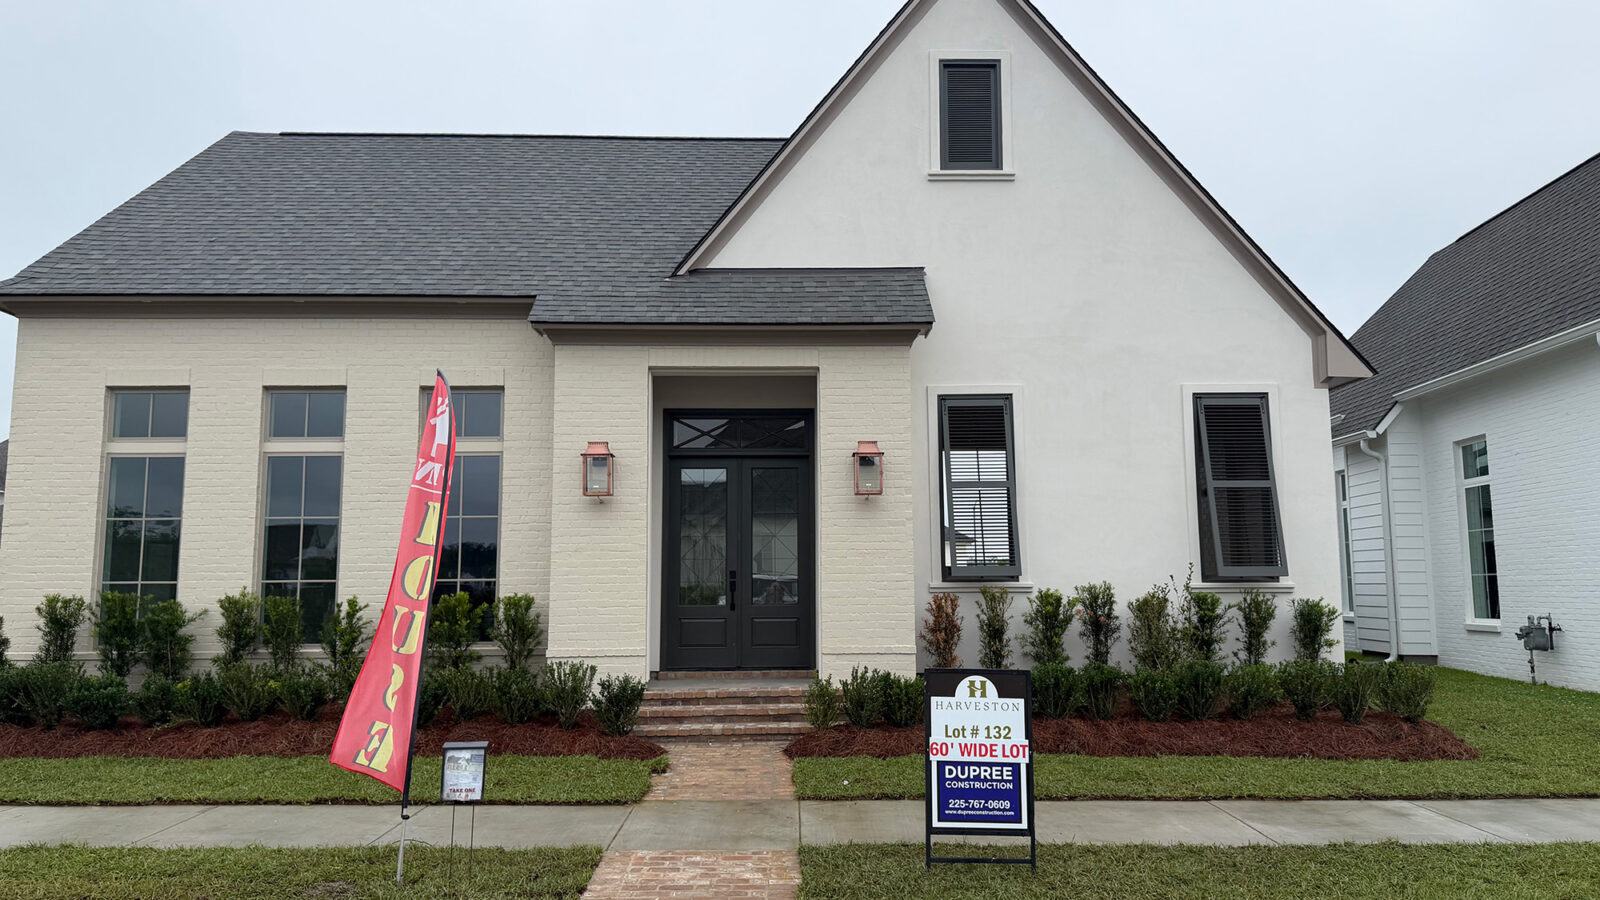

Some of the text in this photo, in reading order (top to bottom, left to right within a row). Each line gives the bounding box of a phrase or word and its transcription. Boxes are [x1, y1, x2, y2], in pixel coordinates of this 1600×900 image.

[935, 700, 1020, 712] HARVESTON
[944, 724, 1012, 740] Lot # 132
[930, 742, 1029, 759] 60' WIDE LOT
[945, 765, 1013, 780] DUPREE
[945, 781, 1013, 790] CONSTRUCTION
[949, 799, 1011, 809] 225-767-0609
